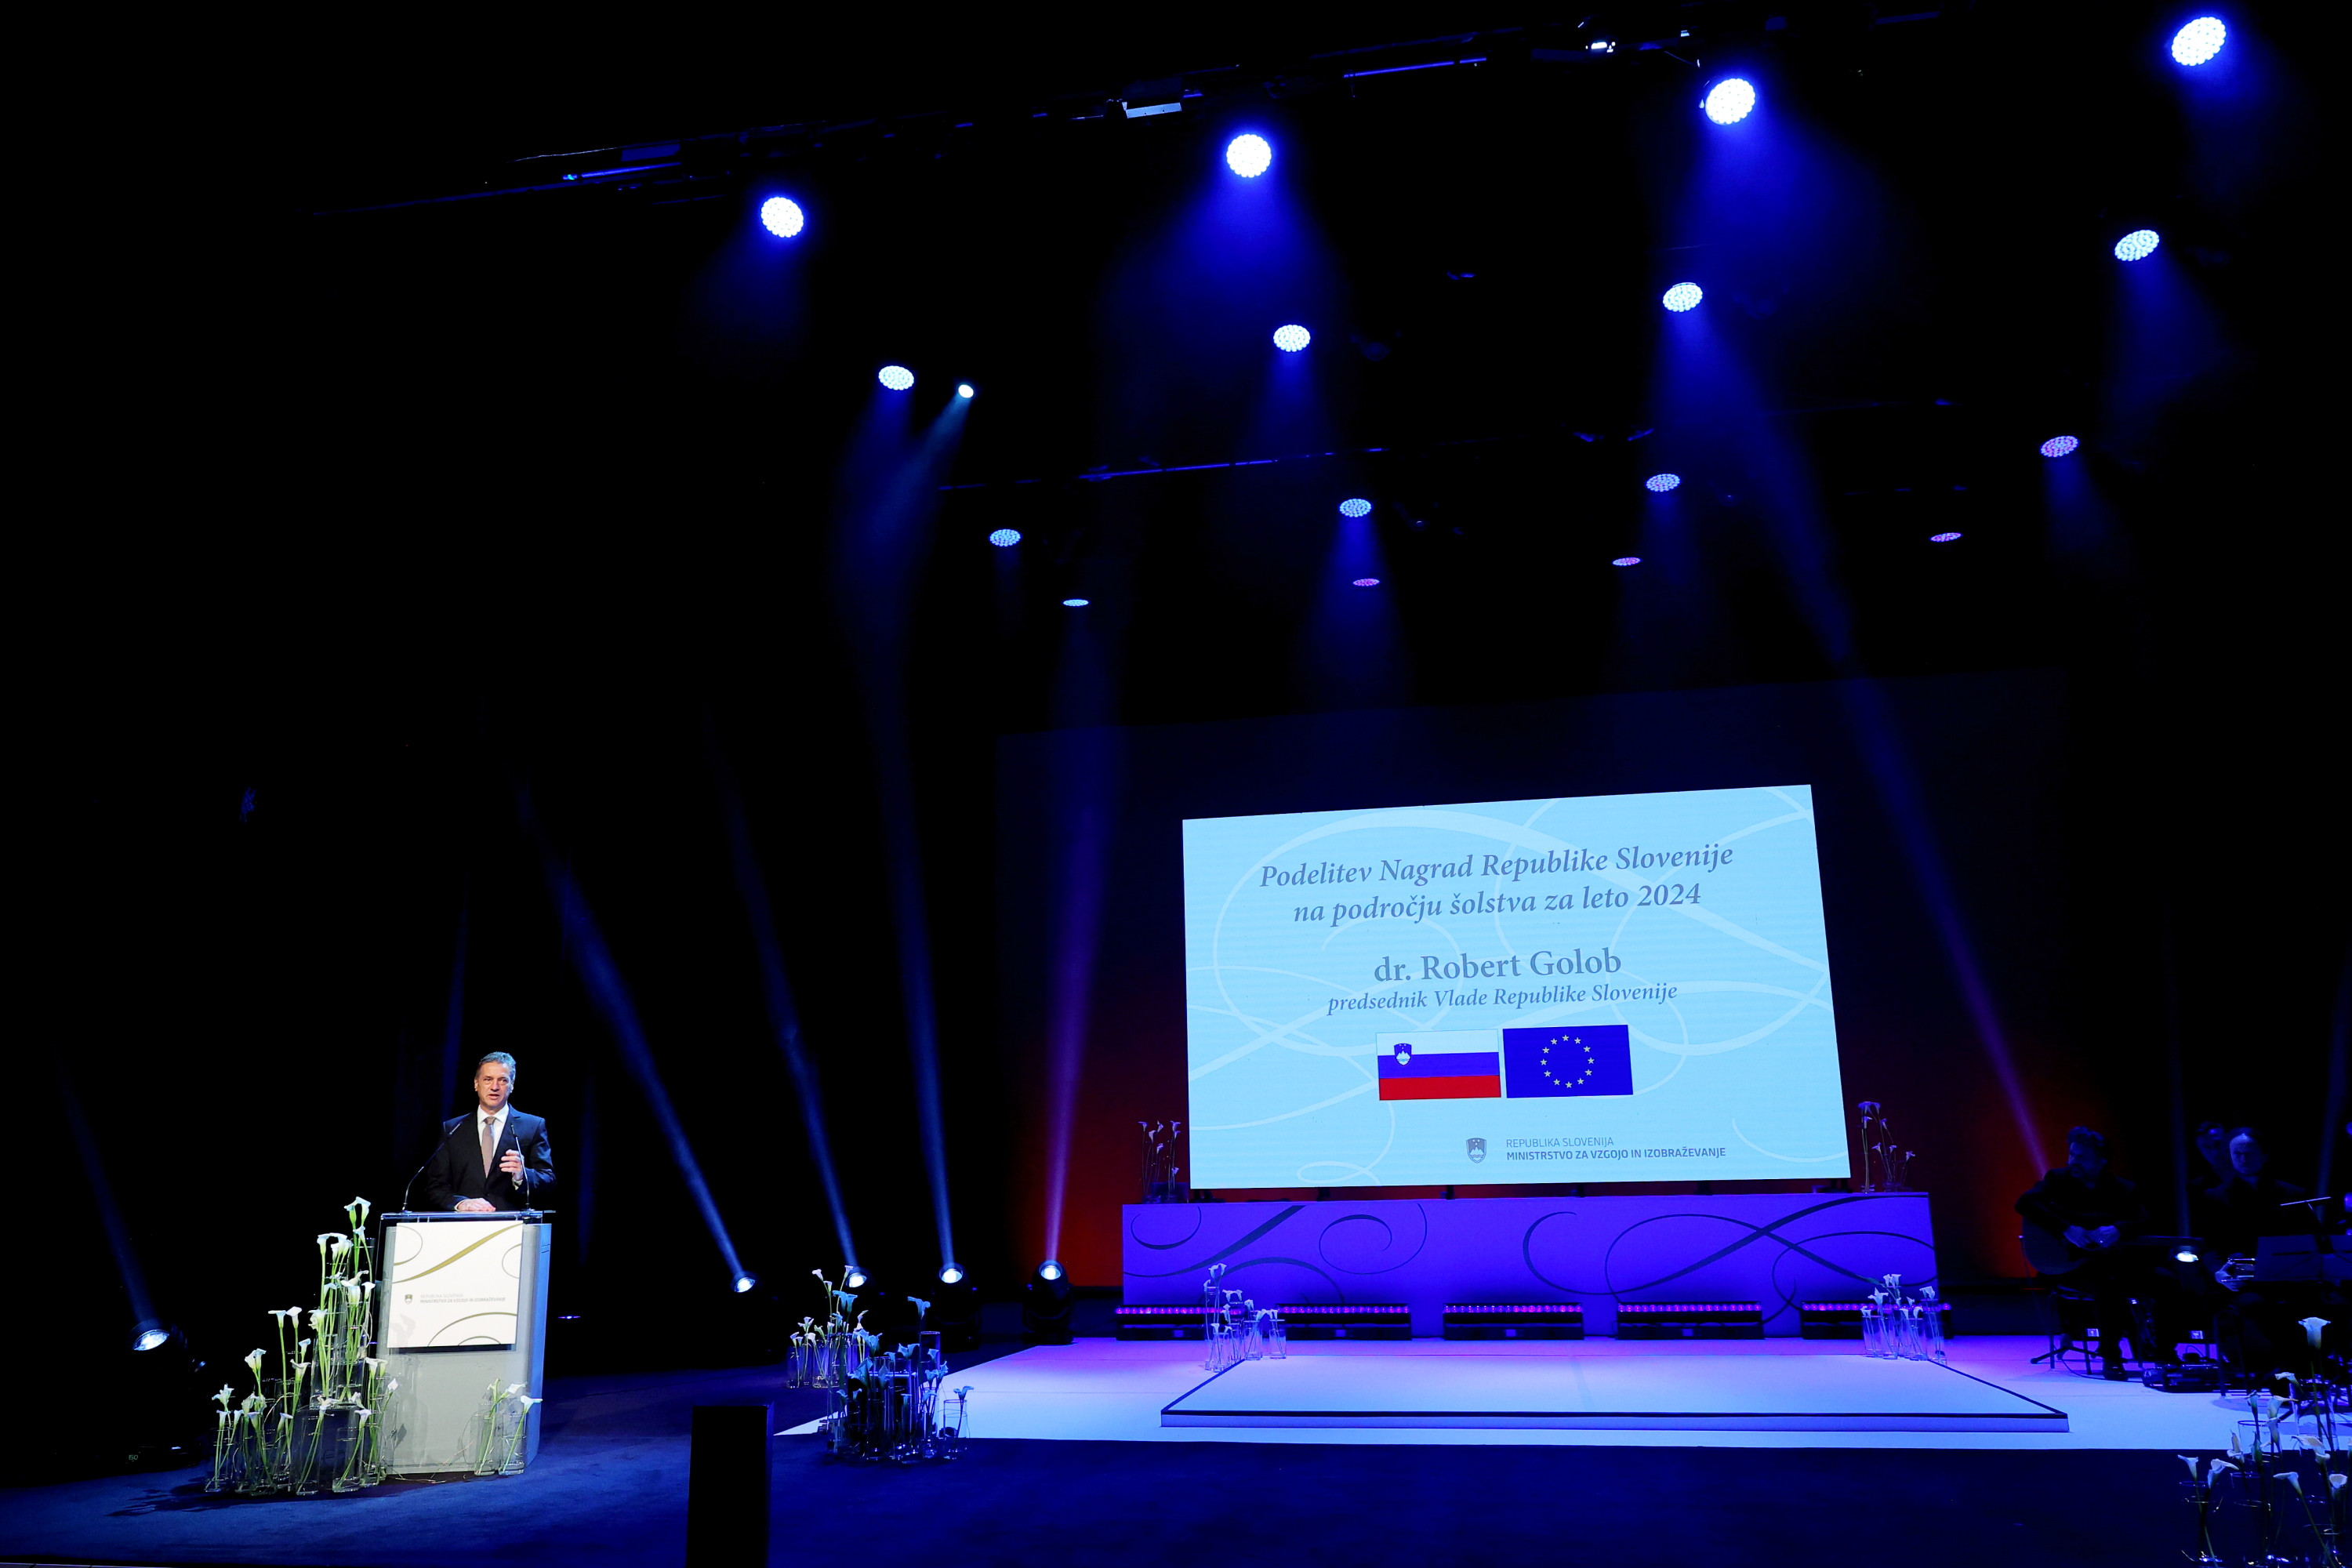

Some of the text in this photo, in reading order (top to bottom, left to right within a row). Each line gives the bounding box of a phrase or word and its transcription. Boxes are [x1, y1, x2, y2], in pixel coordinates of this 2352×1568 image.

[1259, 844, 1733, 887] Podelitev Nagrad Republike Slovenije
[1294, 883, 1701, 927] na področju šolstva za leto 2024
[1374, 947, 1621, 982] dr. Robert Golob
[1327, 982, 1678, 1016] predsednik Vlade Republike Slovenije
[1506, 1137, 1614, 1149] REPUBLIKA SLOVENIJA
[1507, 1146, 1726, 1160] MINISTRSTVO ZA VZGOJO IN IZOBRAŽEVANJE
